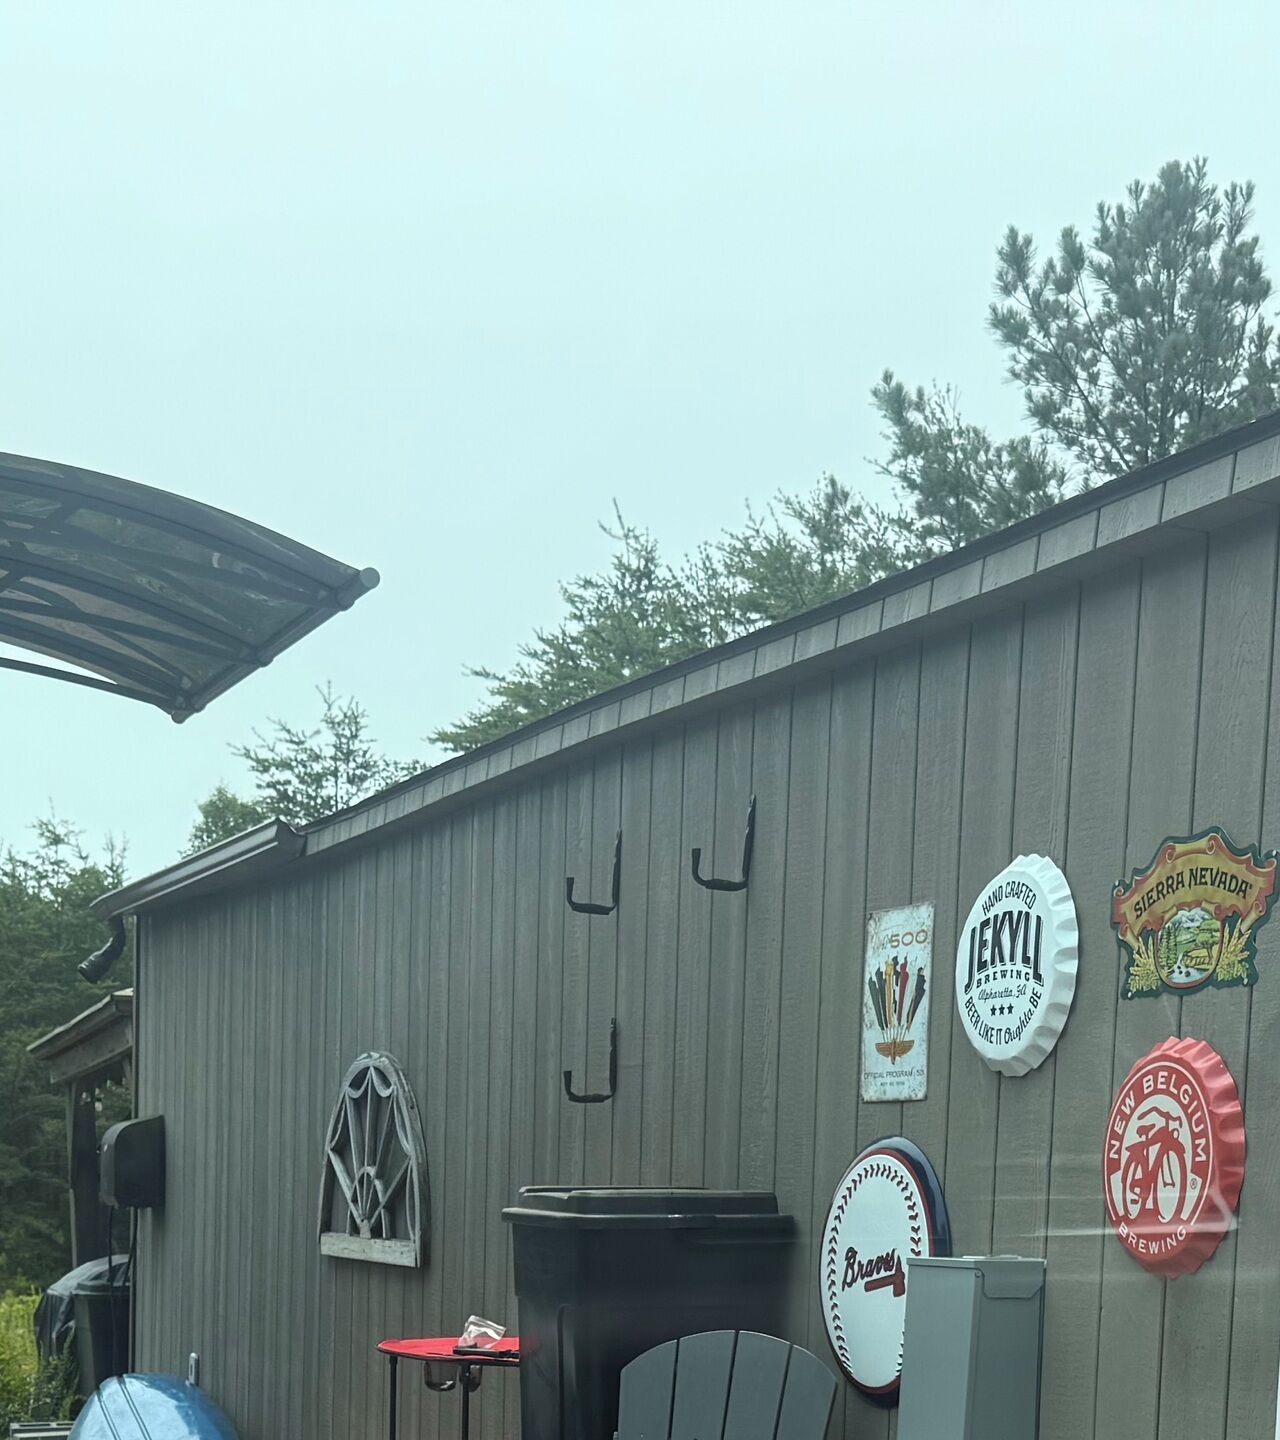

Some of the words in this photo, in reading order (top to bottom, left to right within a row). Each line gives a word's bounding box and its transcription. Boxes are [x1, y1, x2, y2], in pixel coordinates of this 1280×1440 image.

[981, 885, 1003, 916] HAND
[1005, 881, 1037, 910] CRAFTED
[1134, 871, 1185, 920] SIERRA
[890, 929, 928, 948] 500
[964, 910, 1044, 995] JEKYLL
[976, 969, 1030, 989] BREWING
[964, 996, 981, 1030] BEER
[978, 1020, 995, 1045] LIKE
[995, 1028, 1003, 1045] IT
[1029, 987, 1042, 1009] BE
[1109, 1091, 1135, 1159] NEW
[1142, 1071, 1207, 1162] BELGIUM
[1118, 1222, 1187, 1254] BREWING
[842, 1246, 897, 1292] Braves
